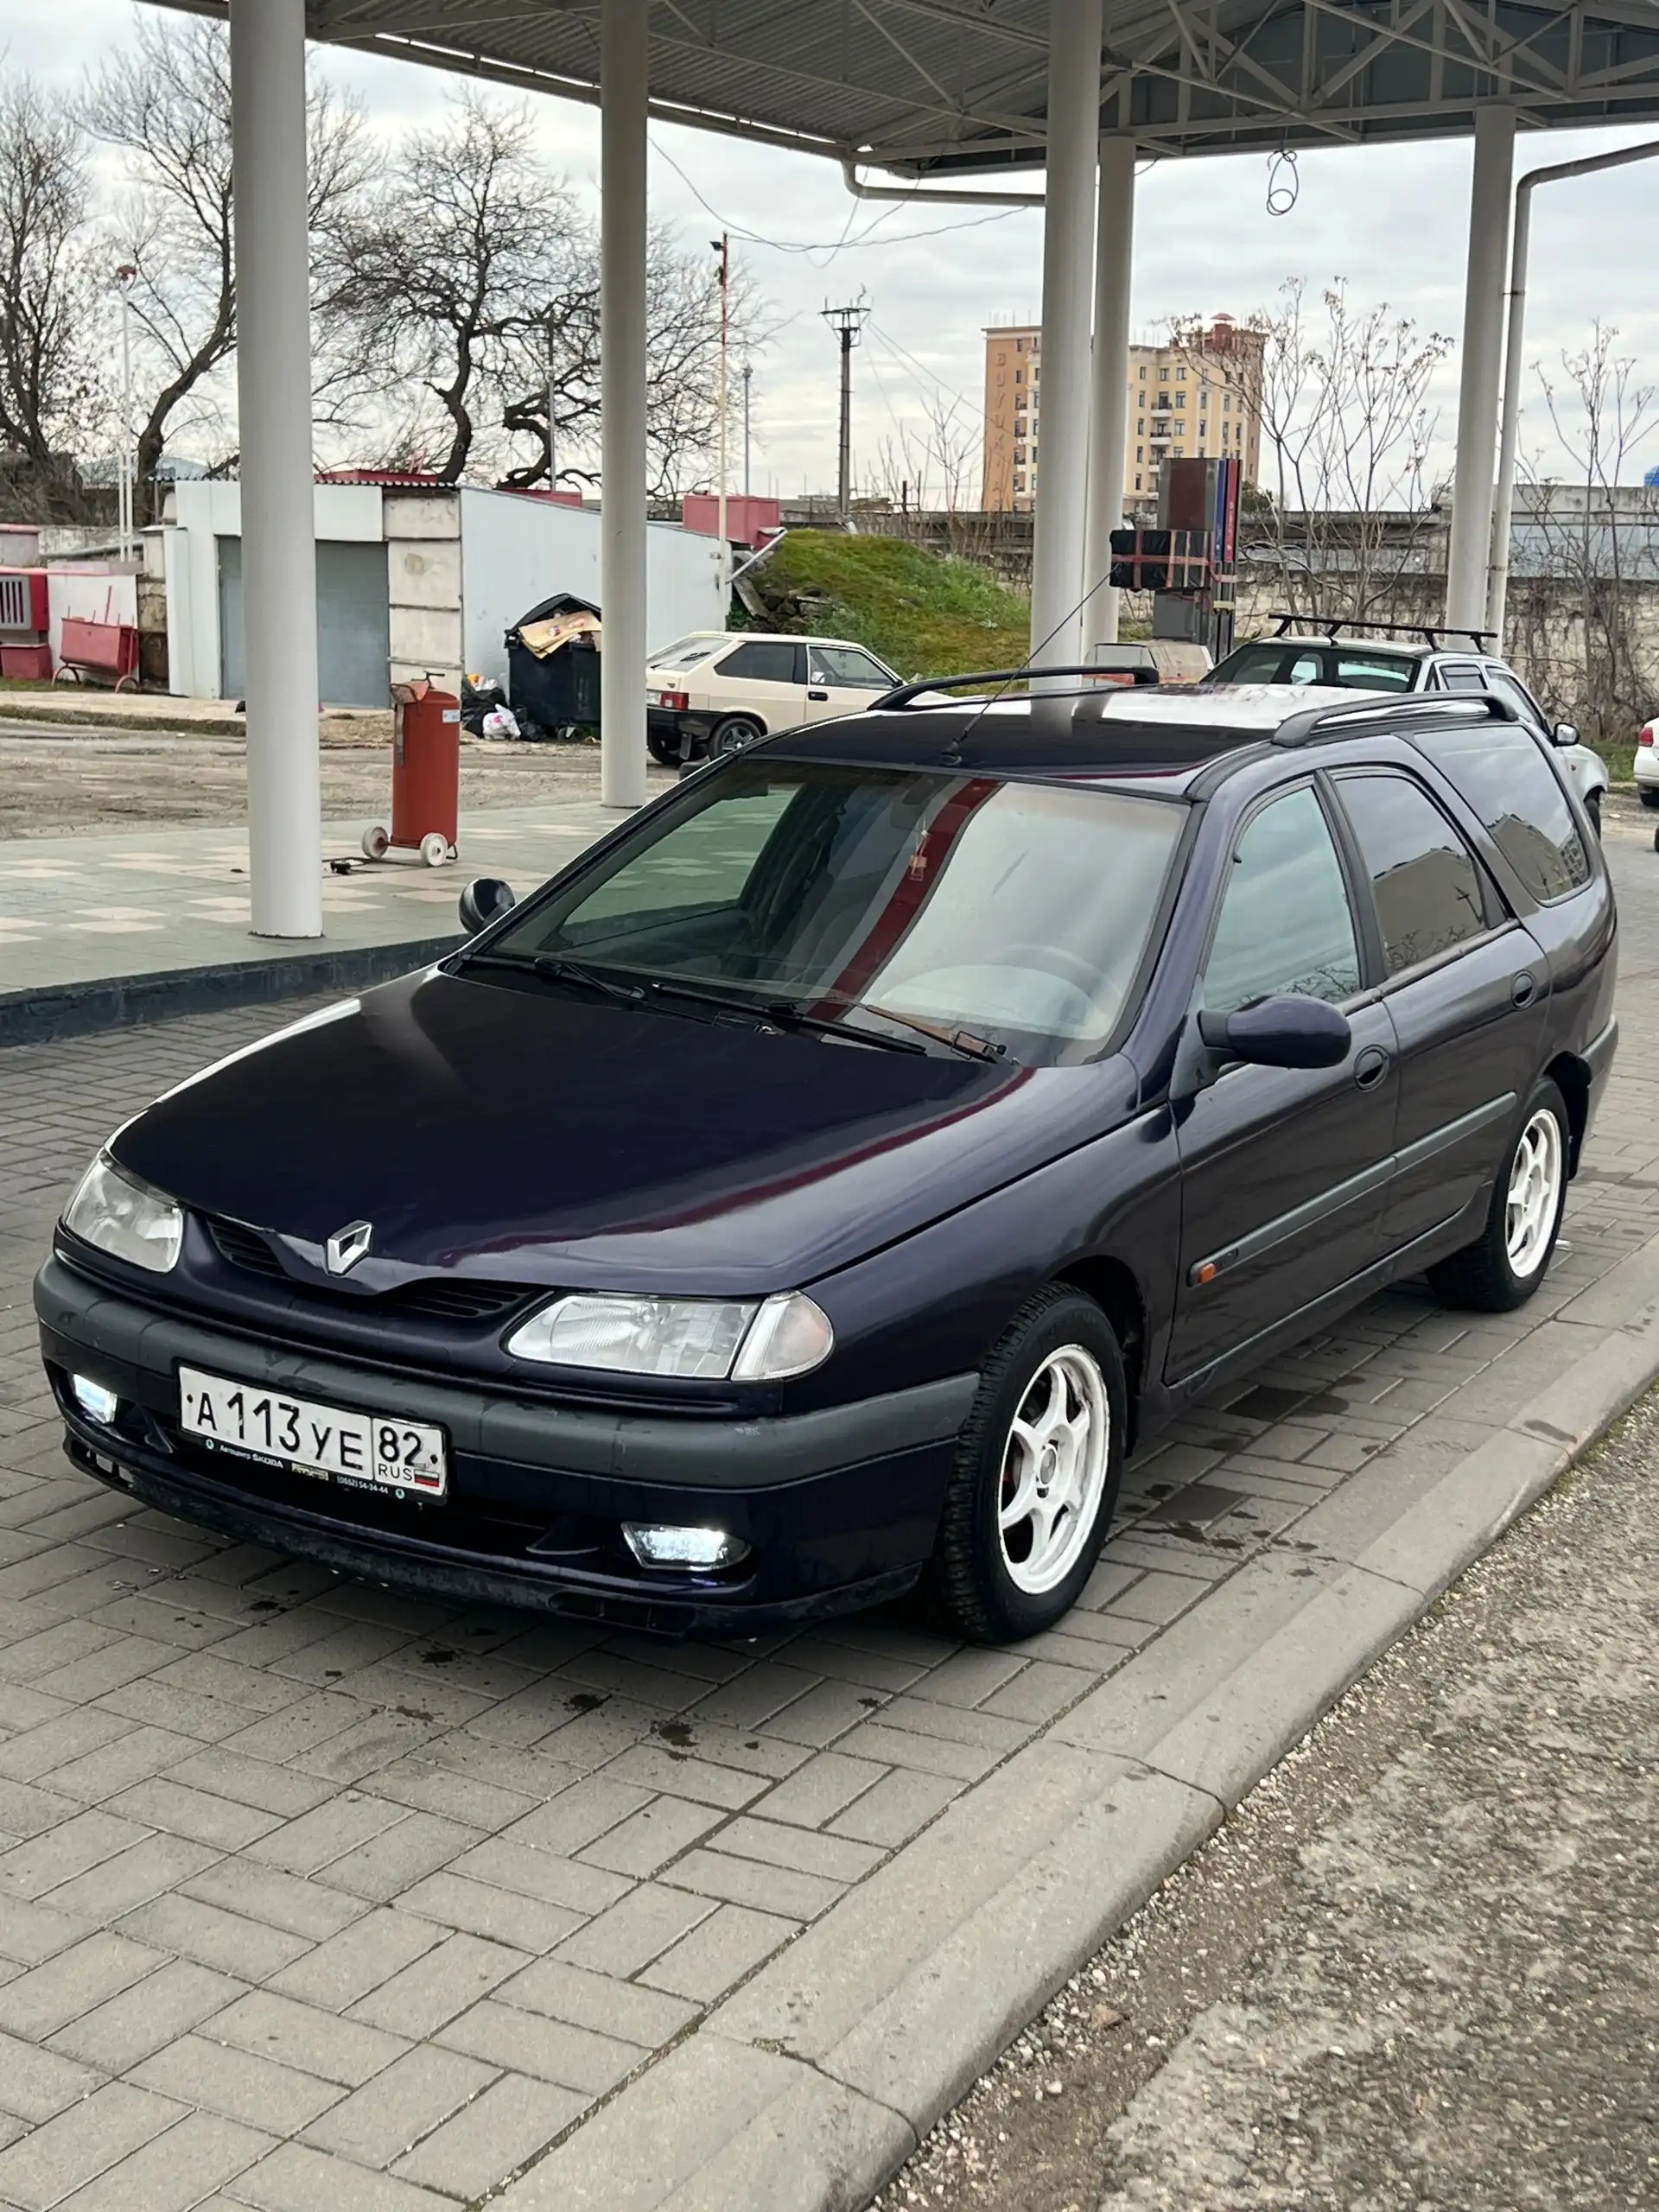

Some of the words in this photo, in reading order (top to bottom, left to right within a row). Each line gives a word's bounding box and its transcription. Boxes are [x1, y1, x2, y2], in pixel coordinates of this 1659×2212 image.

[197, 1392, 363, 1471] А113УЕ
[378, 1426, 423, 1466] 82
[378, 1464, 413, 1482] RUS
